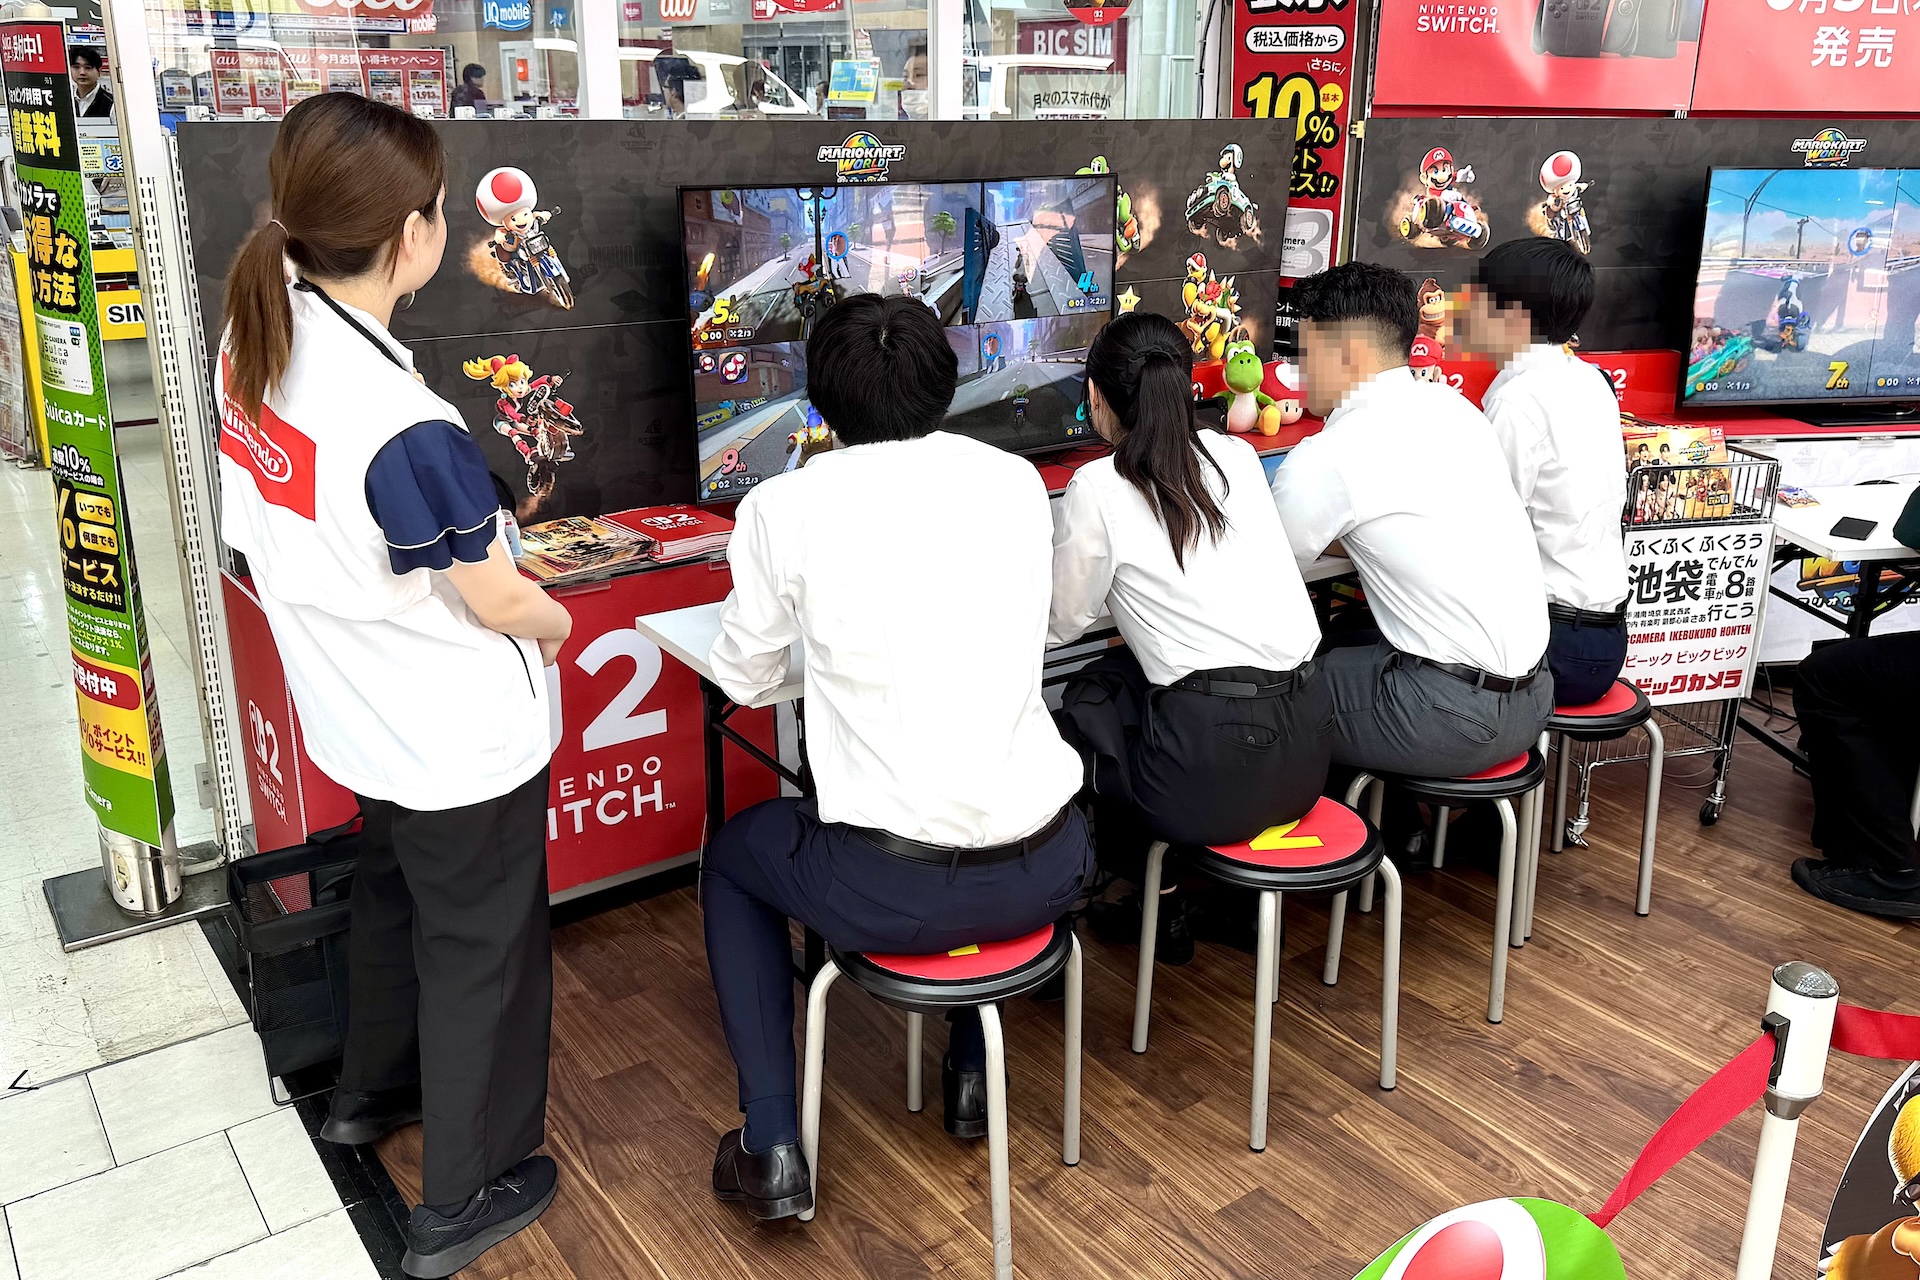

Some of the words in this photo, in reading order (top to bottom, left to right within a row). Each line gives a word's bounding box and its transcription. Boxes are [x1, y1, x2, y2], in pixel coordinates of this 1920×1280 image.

[1419, 4, 1498, 16] NINTENDO
[1033, 29, 1069, 56] BIC
[1074, 27, 1111, 55] SIM
[1253, 31, 1339, 48] 税込価格から
[1811, 26, 1896, 68] 発売
[1311, 57, 1342, 73] さらに
[1322, 93, 1340, 103] 基本
[1809, 149, 1847, 159] WORLD
[839, 158, 886, 171] WORLD
[1077, 271, 1098, 293] 4th
[712, 299, 739, 324] 5th
[710, 332, 722, 340] 00
[1825, 361, 1849, 390] 7th
[1886, 377, 1899, 386] 00
[1074, 426, 1083, 435] 12
[722, 448, 747, 474] 9th
[718, 480, 730, 489] 02
[79, 501, 111, 518] いつでも
[82, 531, 115, 548] 何度でも
[1630, 537, 1695, 556] ふくふく
[1699, 533, 1763, 553] ふくろう
[1706, 554, 1758, 570] でんでん
[1626, 559, 1703, 605] 池袋
[1669, 627, 1718, 641] IKEBUKURO
[1720, 624, 1752, 637] HONTEN
[1625, 653, 1673, 668] ビーック
[1635, 669, 1743, 696] ビックカメラ
[93, 723, 135, 748] ポイント
[94, 739, 146, 766] サービス!!
[559, 755, 662, 798] ENDO
